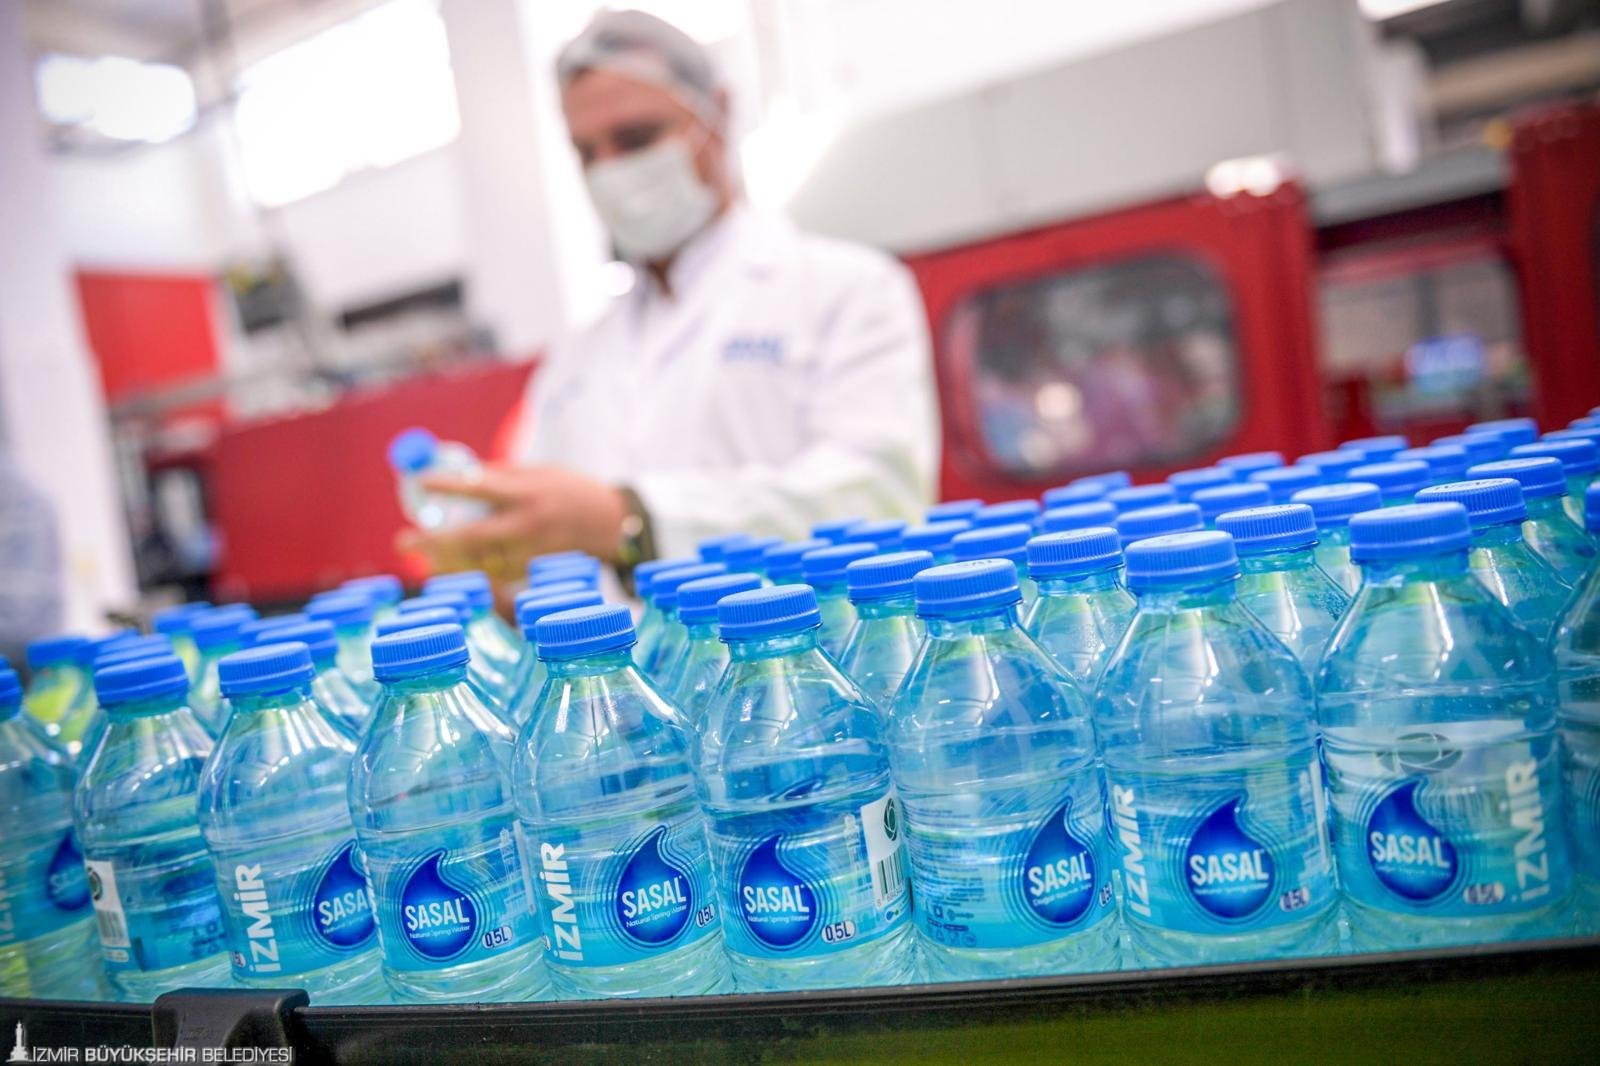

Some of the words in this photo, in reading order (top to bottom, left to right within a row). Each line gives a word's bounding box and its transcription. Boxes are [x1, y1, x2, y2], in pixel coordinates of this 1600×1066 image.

[1189, 849, 1269, 887] SASAL
[1370, 830, 1450, 869] SASAL
[1028, 852, 1092, 897] SASAL
[318, 888, 369, 927] SASA
[404, 897, 470, 932] SASAL
[540, 842, 584, 961] İZMİR
[621, 876, 687, 919] SASAL
[743, 884, 810, 914] SASAL
[234, 863, 282, 973] İZMİR
